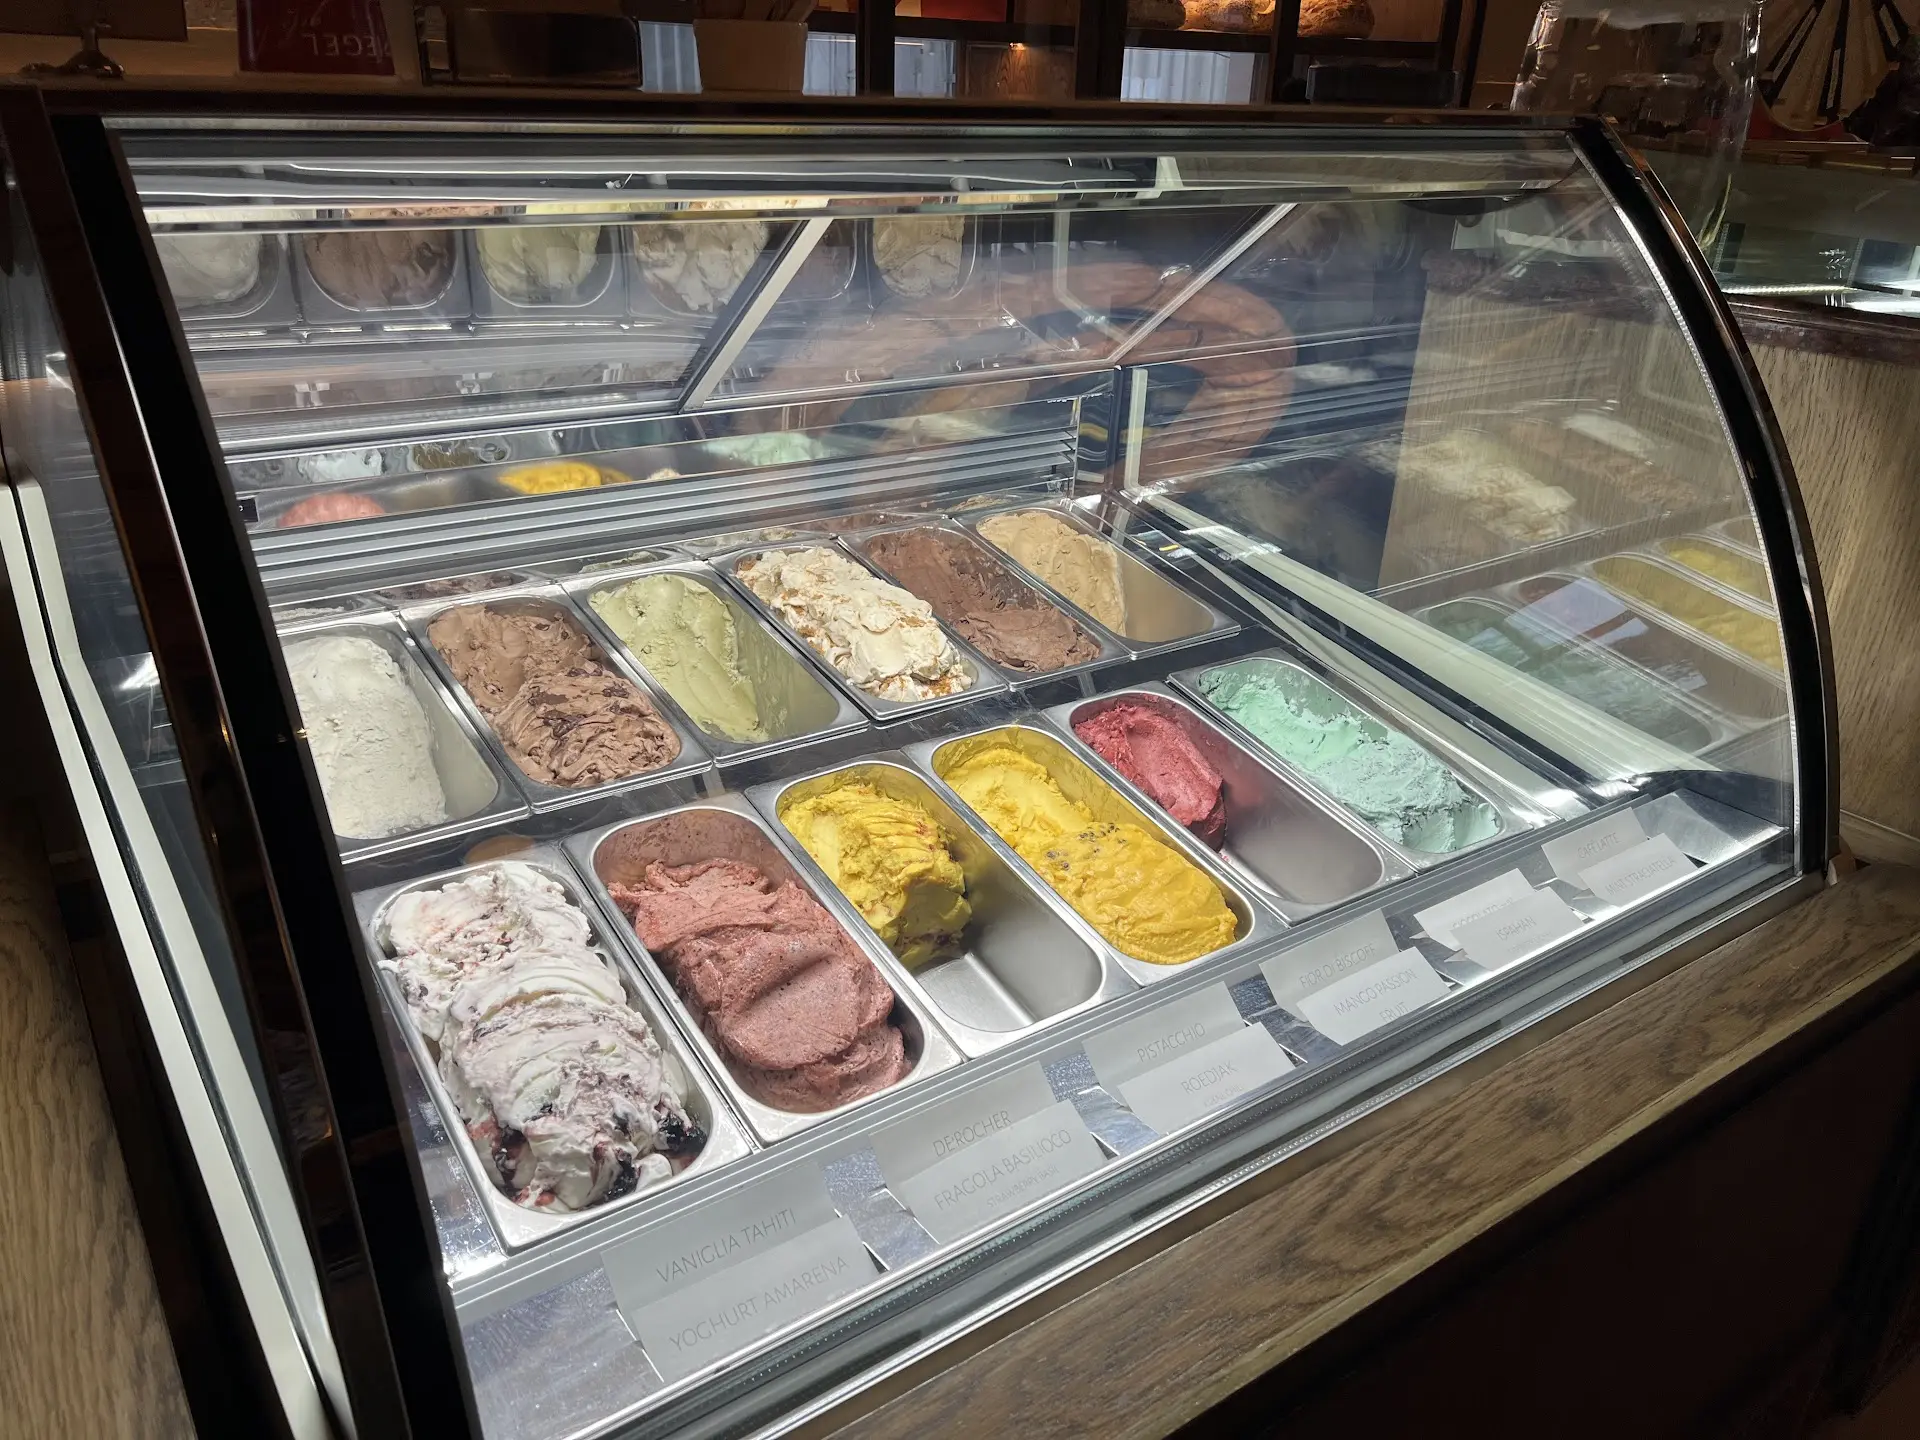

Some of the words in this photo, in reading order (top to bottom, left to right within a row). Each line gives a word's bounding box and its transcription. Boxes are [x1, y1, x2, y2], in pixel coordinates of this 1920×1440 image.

[1598, 831, 1622, 853] LATTE
[1299, 968, 1324, 989] FIOR
[1324, 963, 1336, 979] DI
[1336, 942, 1377, 973] BISCOFF
[1376, 968, 1418, 996] PASSION
[1380, 1001, 1411, 1024] FRUIT
[1136, 1022, 1206, 1063] PISTACCHIO
[1180, 1060, 1240, 1095] ROEDJAK
[933, 1162, 1006, 1211] FRAGOLA
[655, 1232, 743, 1284] VANIGLIA
[741, 1206, 798, 1246] TAHITI
[668, 1295, 758, 1354] YOGHURT
[764, 1255, 851, 1308] AMARENA
